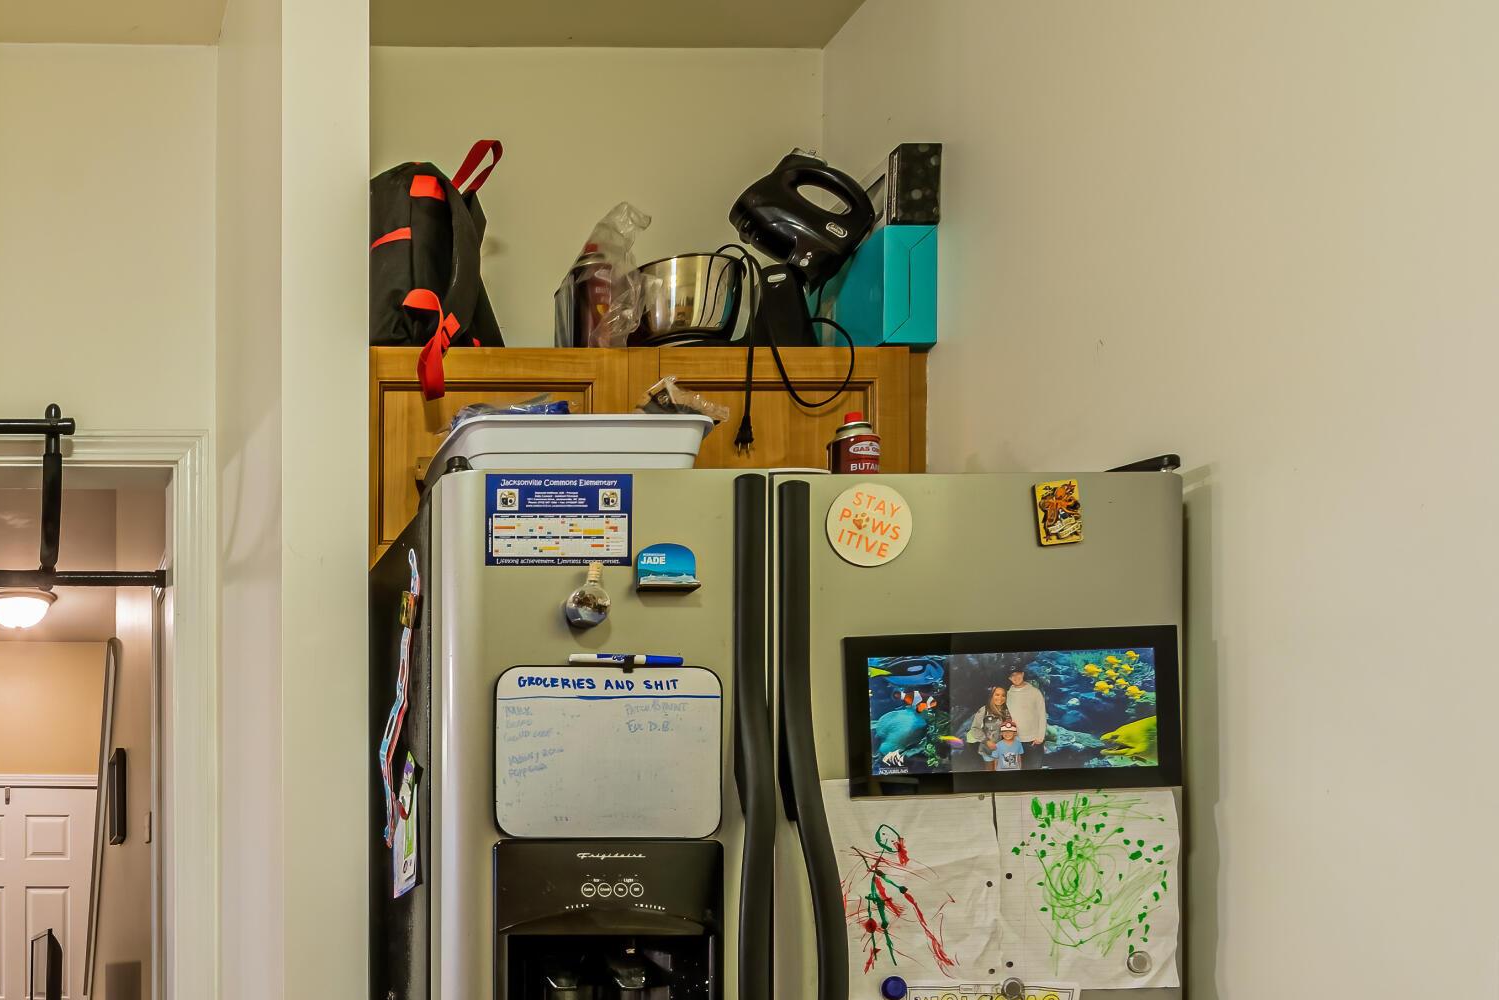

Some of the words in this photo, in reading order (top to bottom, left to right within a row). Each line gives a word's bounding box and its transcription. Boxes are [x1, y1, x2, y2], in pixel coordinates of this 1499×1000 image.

[500, 479, 542, 487] Jacksonville
[543, 479, 577, 487] Commons
[579, 479, 618, 487] Elementary
[852, 491, 901, 518] STAY
[837, 528, 890, 558] ITIVE
[640, 556, 666, 565] JADE
[517, 675, 597, 690] GROCERIES
[604, 679, 635, 691] AND
[643, 679, 679, 691] SHIT
[576, 852, 646, 860] Frigidaire
